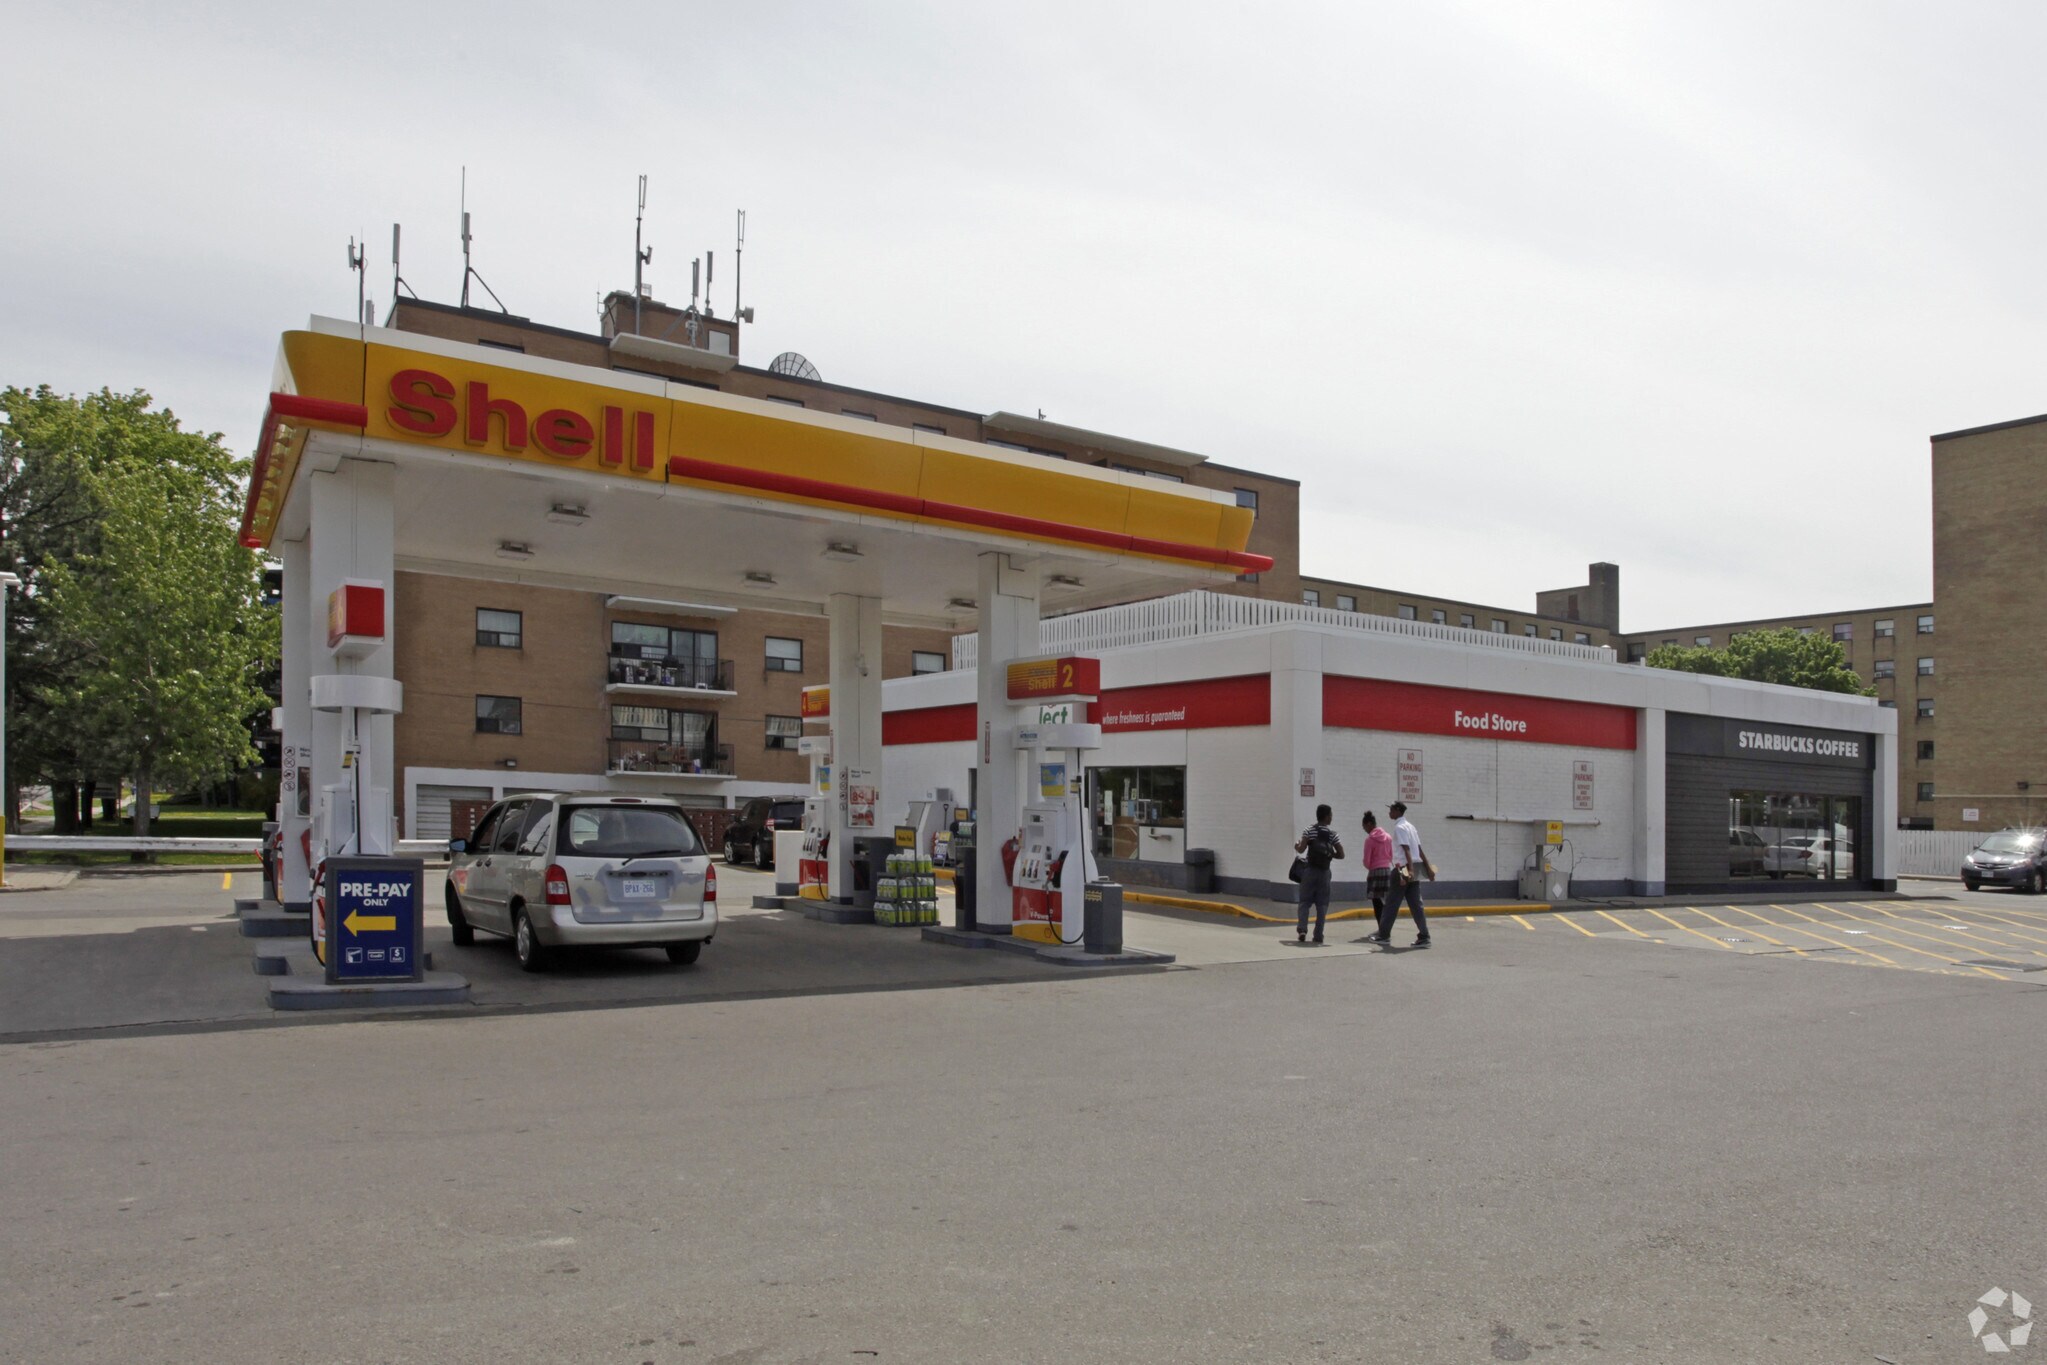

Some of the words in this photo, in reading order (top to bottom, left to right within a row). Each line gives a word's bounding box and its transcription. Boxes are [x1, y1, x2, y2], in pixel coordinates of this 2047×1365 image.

[385, 368, 655, 472] Shell
[1028, 677, 1056, 691] Shell
[1062, 664, 1073, 688] 2
[1102, 712, 1119, 725] where
[1120, 710, 1144, 724] freshness
[1145, 711, 1150, 723] is
[1151, 706, 1185, 725] guaranteed
[1455, 710, 1489, 730] Food
[1491, 713, 1527, 733] Store
[1739, 731, 1814, 754] STARBUCKS
[1815, 739, 1859, 758] COFFEE
[1407, 752, 1415, 761] NO
[1400, 763, 1422, 772] PARKING
[1575, 773, 1593, 781] PARKING
[340, 882, 411, 897] PRE-PAY
